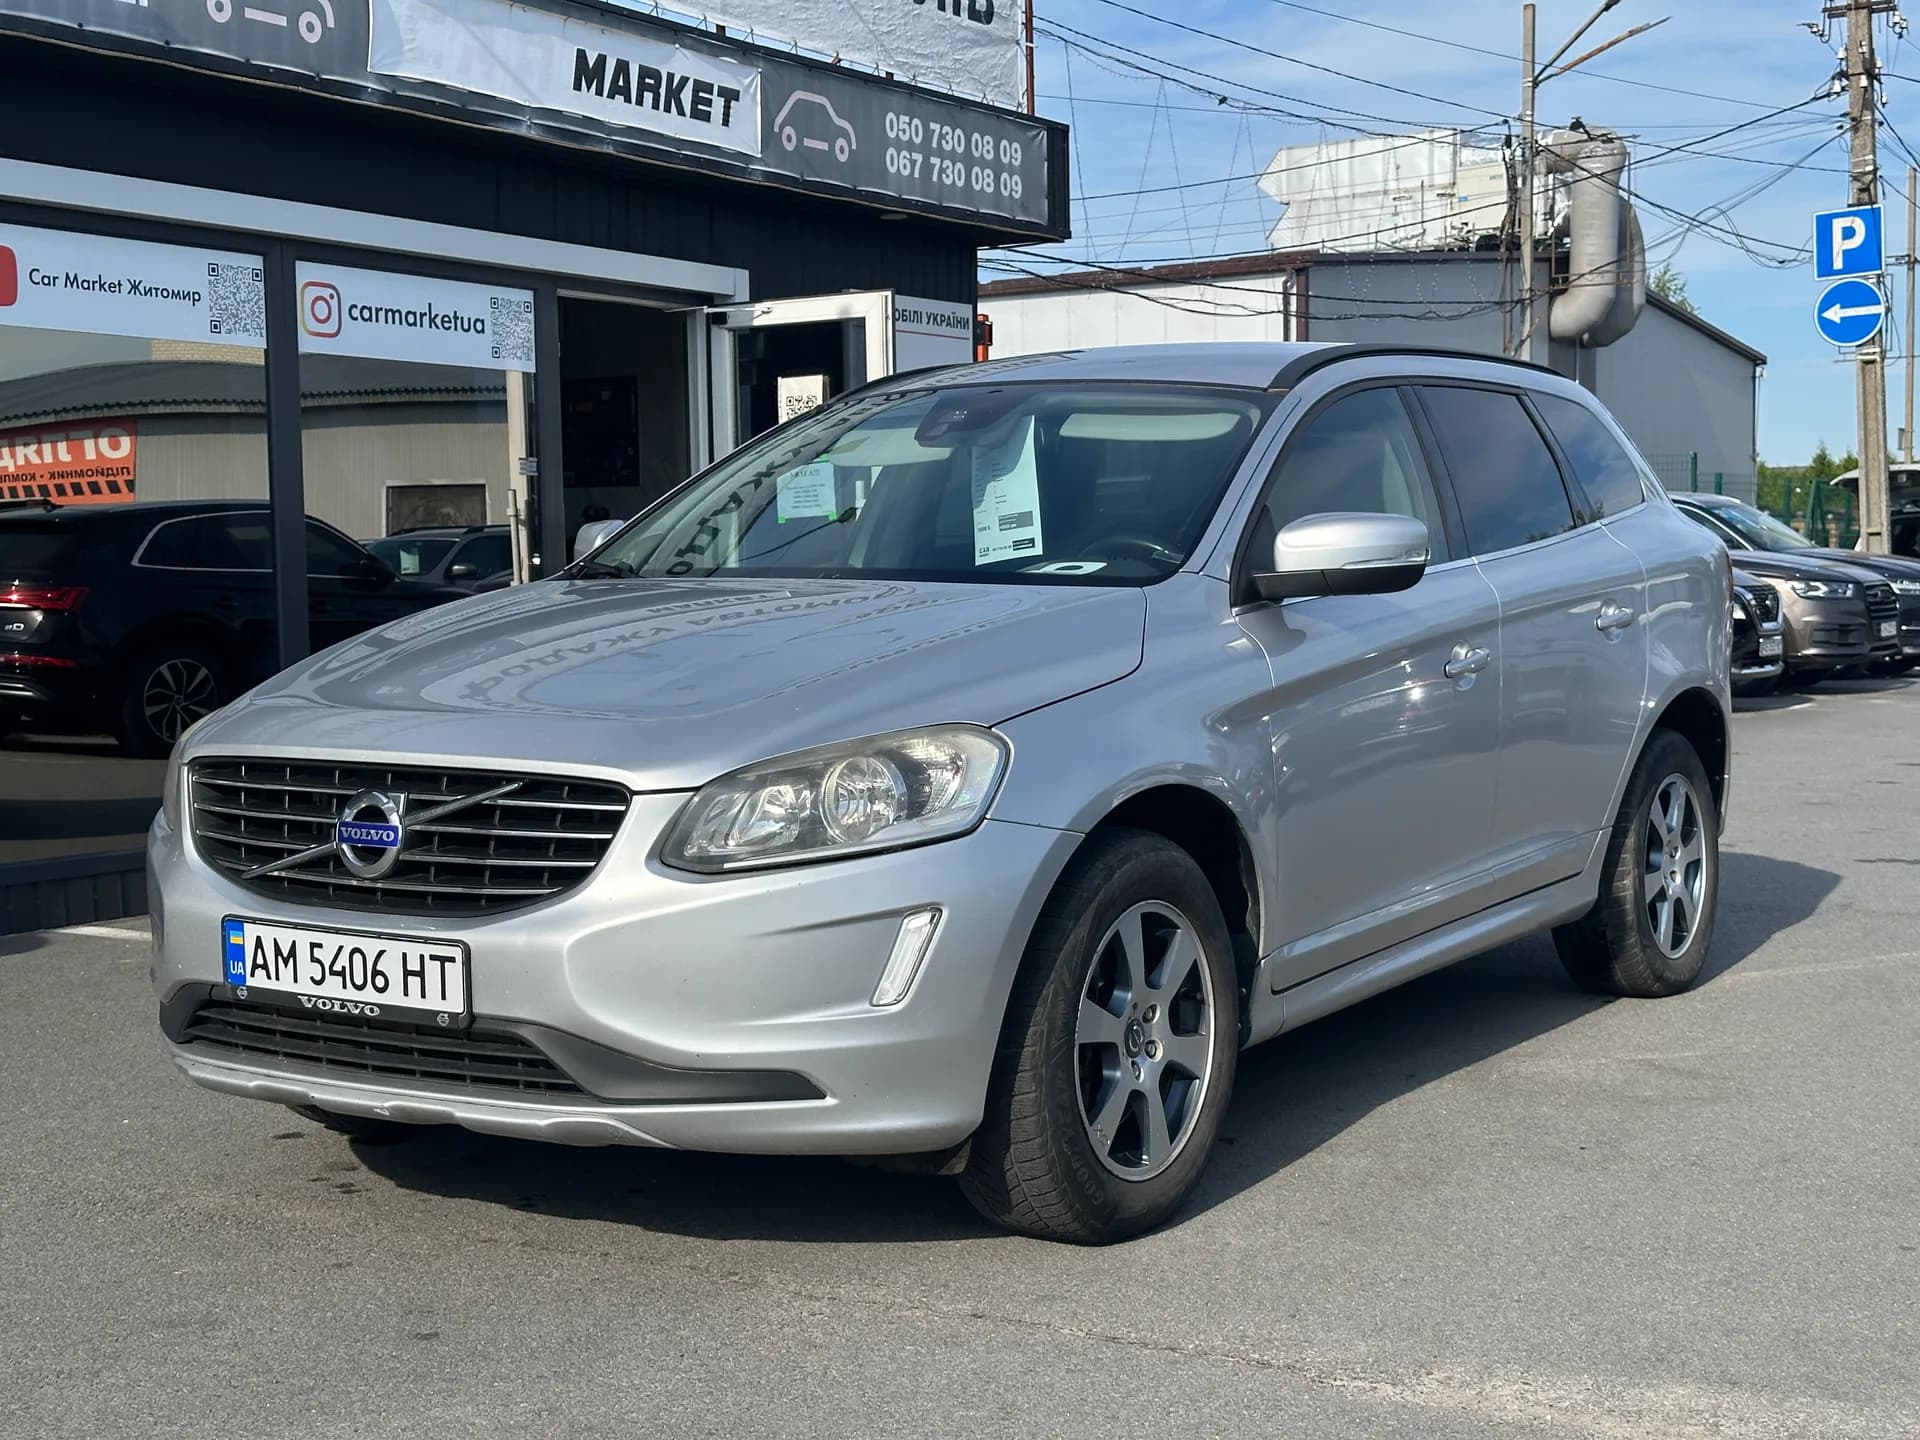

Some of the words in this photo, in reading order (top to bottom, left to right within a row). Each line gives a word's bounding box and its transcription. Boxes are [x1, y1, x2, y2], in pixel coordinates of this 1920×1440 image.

[573, 48, 740, 128] MARKET
[885, 112, 923, 144] 050
[929, 122, 965, 153] 730
[971, 132, 994, 160] 08
[1000, 139, 1022, 166] 09
[886, 147, 923, 178] 067
[930, 156, 965, 187] 730
[971, 166, 994, 193] 08
[1000, 172, 1022, 199] 09
[1832, 216, 1867, 271] P
[29, 268, 59, 287] Car
[64, 272, 123, 294] Market
[127, 278, 201, 307] Житомир
[348, 302, 486, 335] carmarketua
[926, 311, 970, 331] УКРАЇНИ
[340, 826, 395, 842] VOLVO
[230, 961, 244, 975] UA
[250, 935, 298, 984] AM
[309, 941, 390, 994] 5406
[401, 952, 457, 1001] HT
[297, 995, 381, 1016] VOLVO
